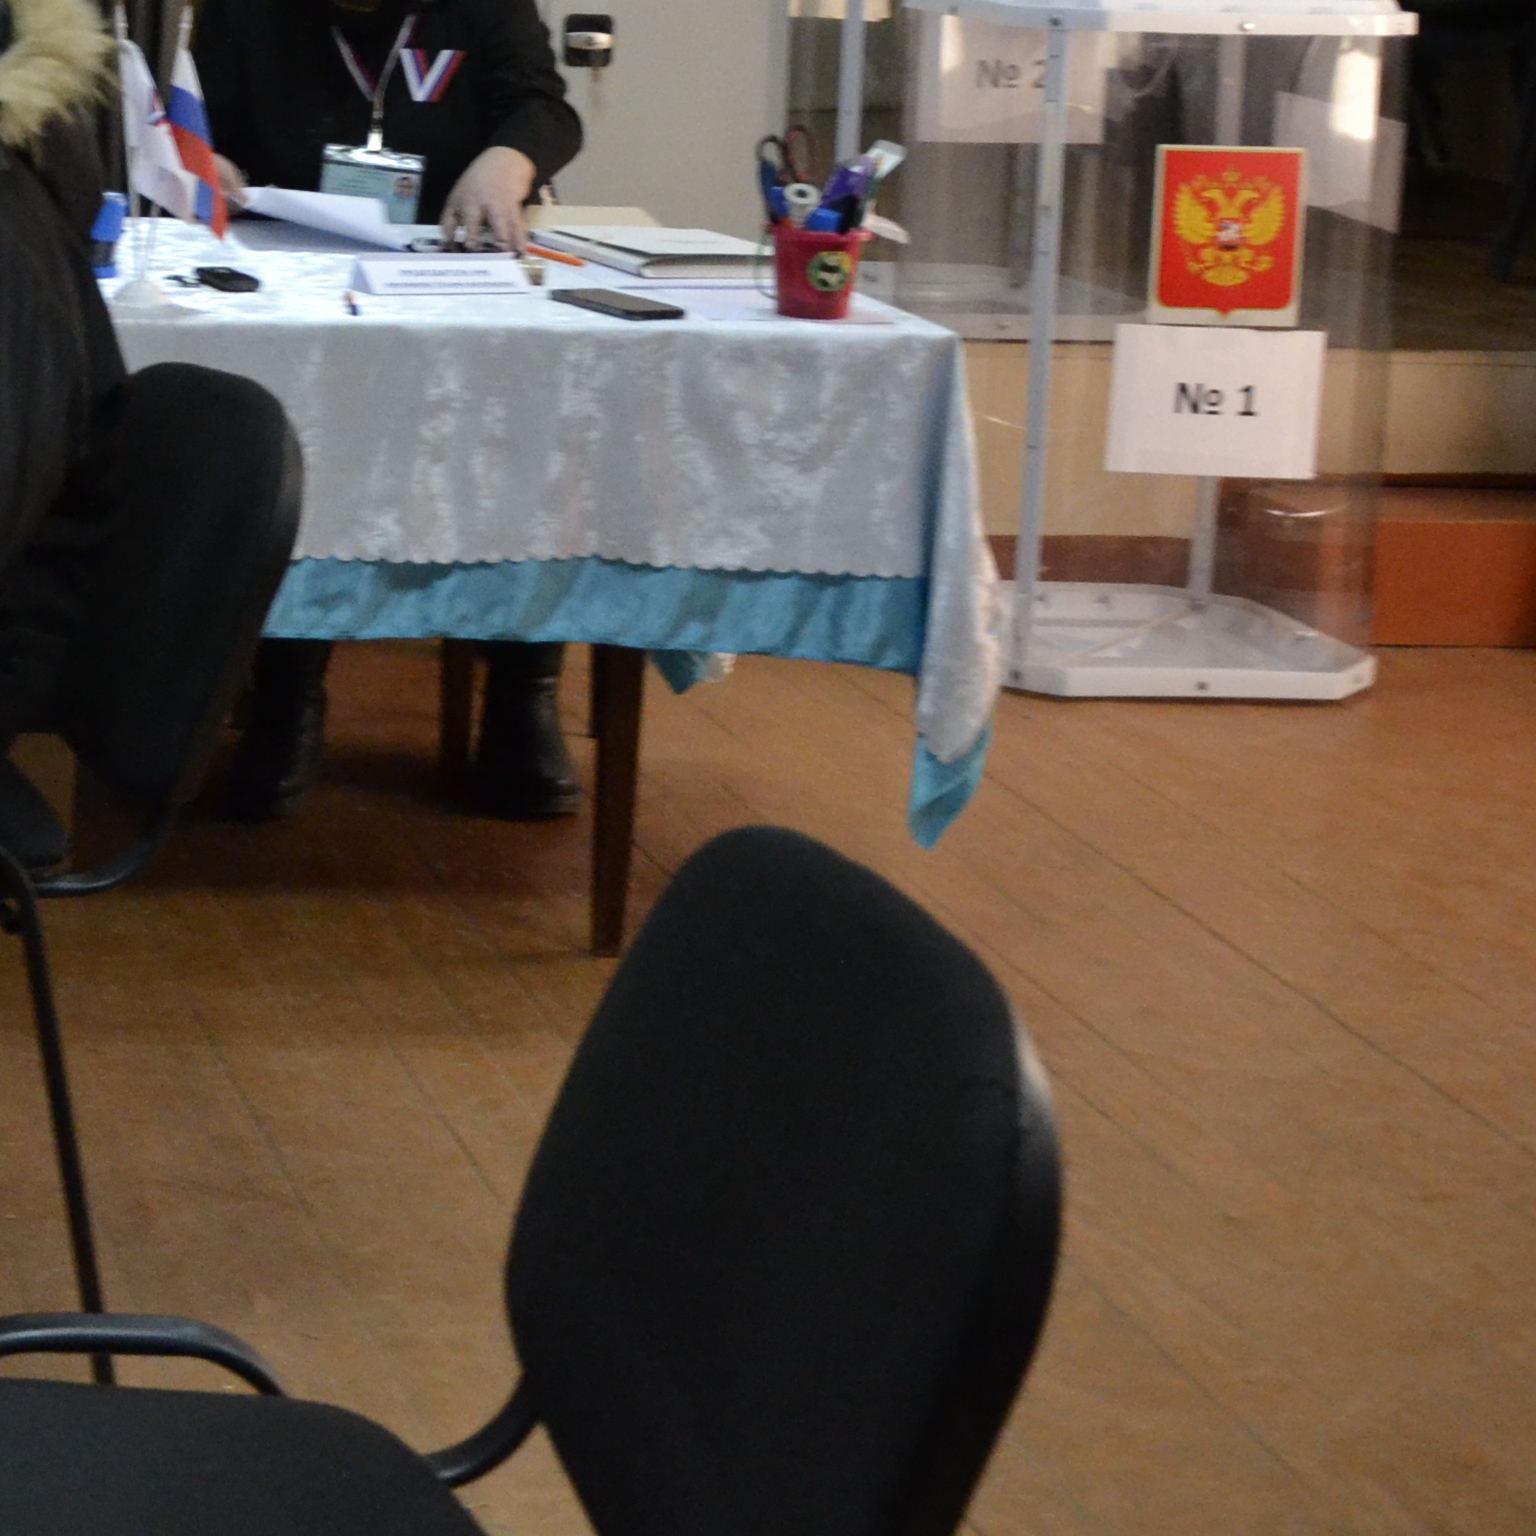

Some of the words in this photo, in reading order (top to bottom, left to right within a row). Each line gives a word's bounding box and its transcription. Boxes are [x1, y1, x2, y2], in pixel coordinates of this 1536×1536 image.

[975, 59, 1021, 89] №
[1173, 382, 1225, 415] №
[1235, 384, 1260, 417] 1
